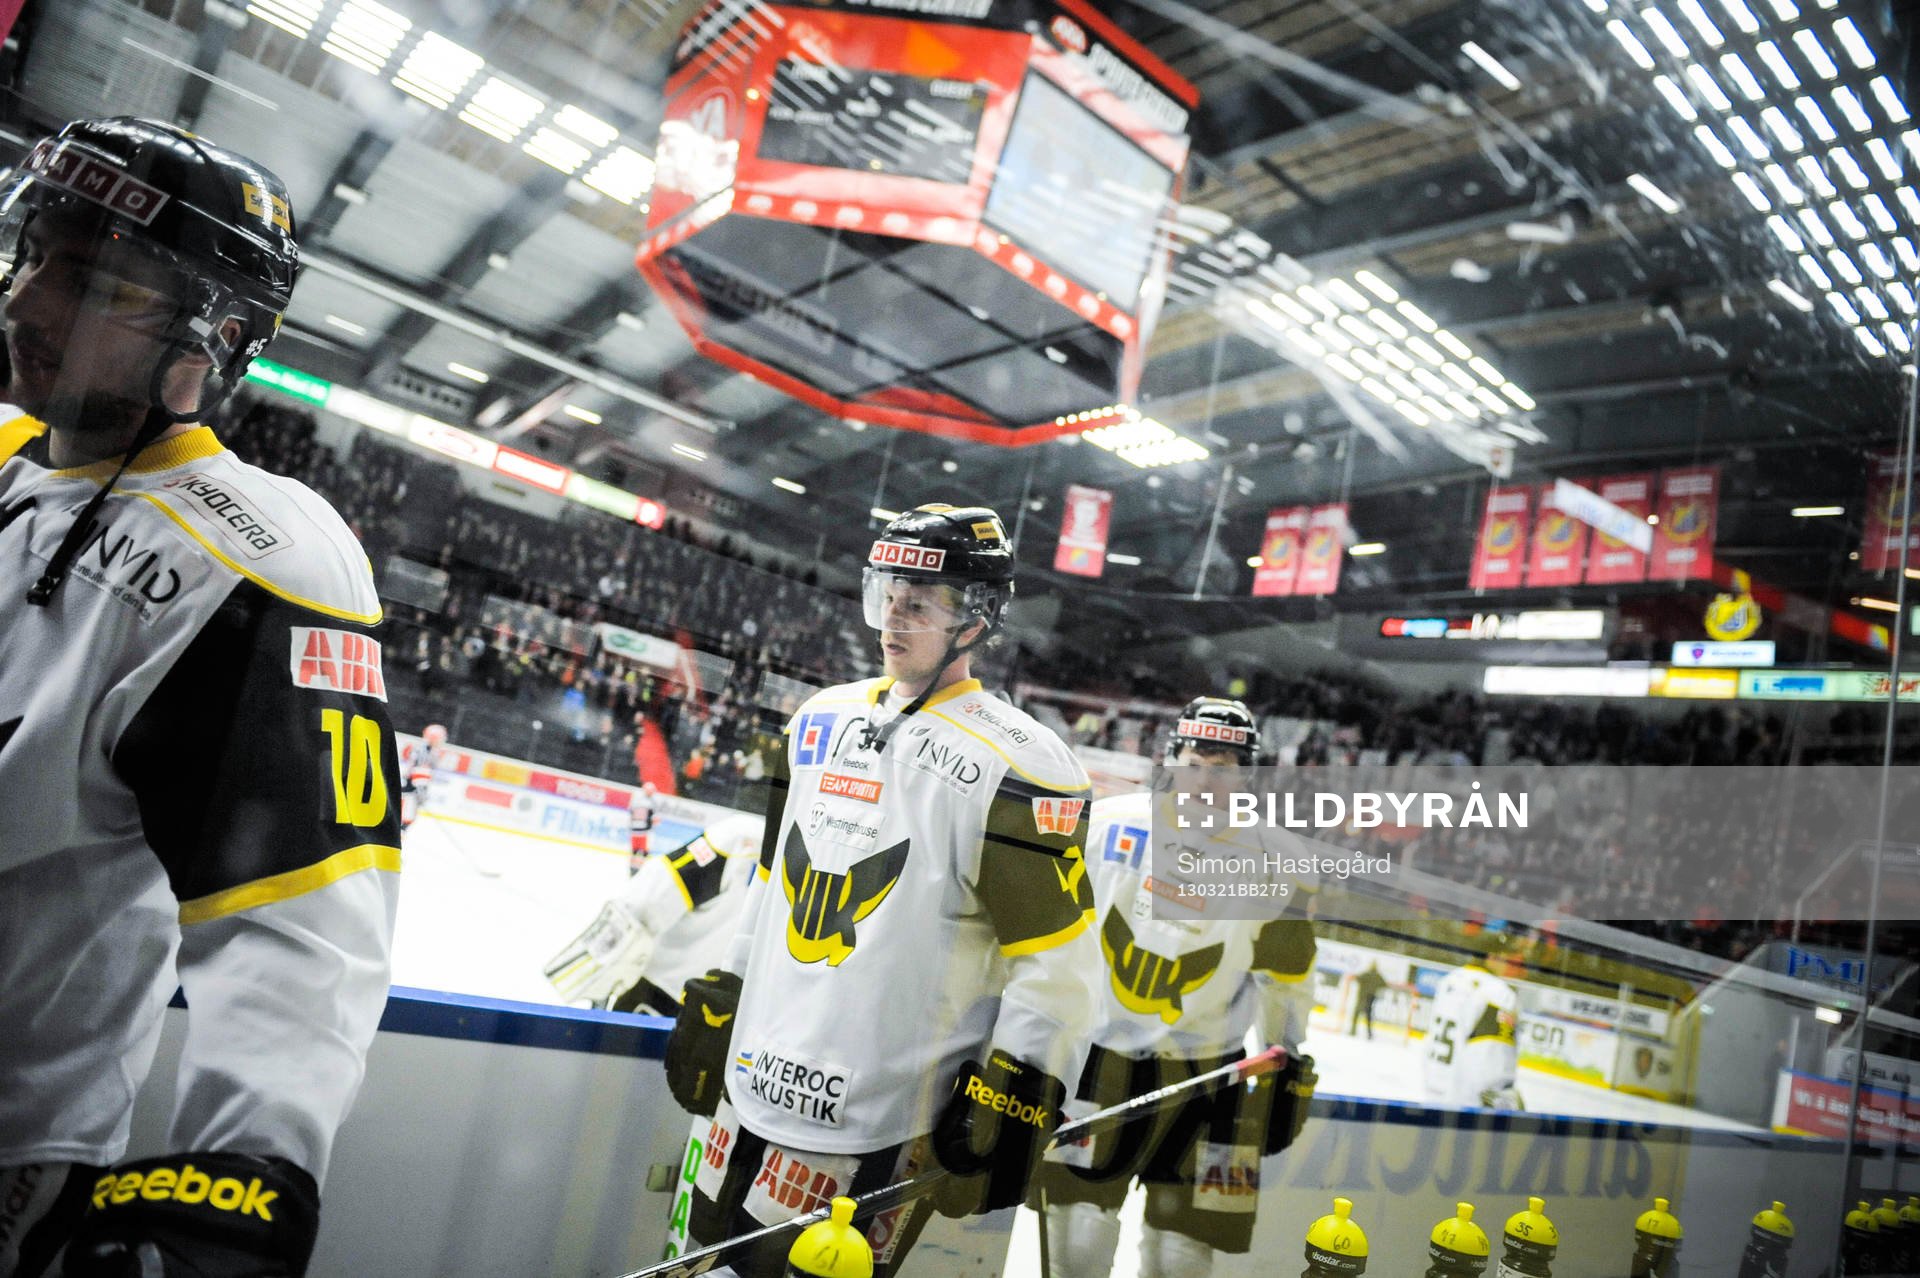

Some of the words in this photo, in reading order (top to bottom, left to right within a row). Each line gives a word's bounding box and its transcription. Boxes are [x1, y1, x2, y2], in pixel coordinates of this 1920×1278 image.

[299, 630, 383, 696] ABB
[321, 708, 388, 828] 10
[842, 757, 870, 772] Reebok
[916, 738, 981, 785] INVID
[826, 815, 878, 839] Westinghouse
[754, 1050, 845, 1098] INTEROC
[751, 1077, 838, 1124] AKUSTIK
[965, 1074, 1049, 1129] Reebok
[92, 1164, 279, 1222] Reebok
[1333, 1234, 1351, 1251] 60
[1515, 1221, 1534, 1237] 35
